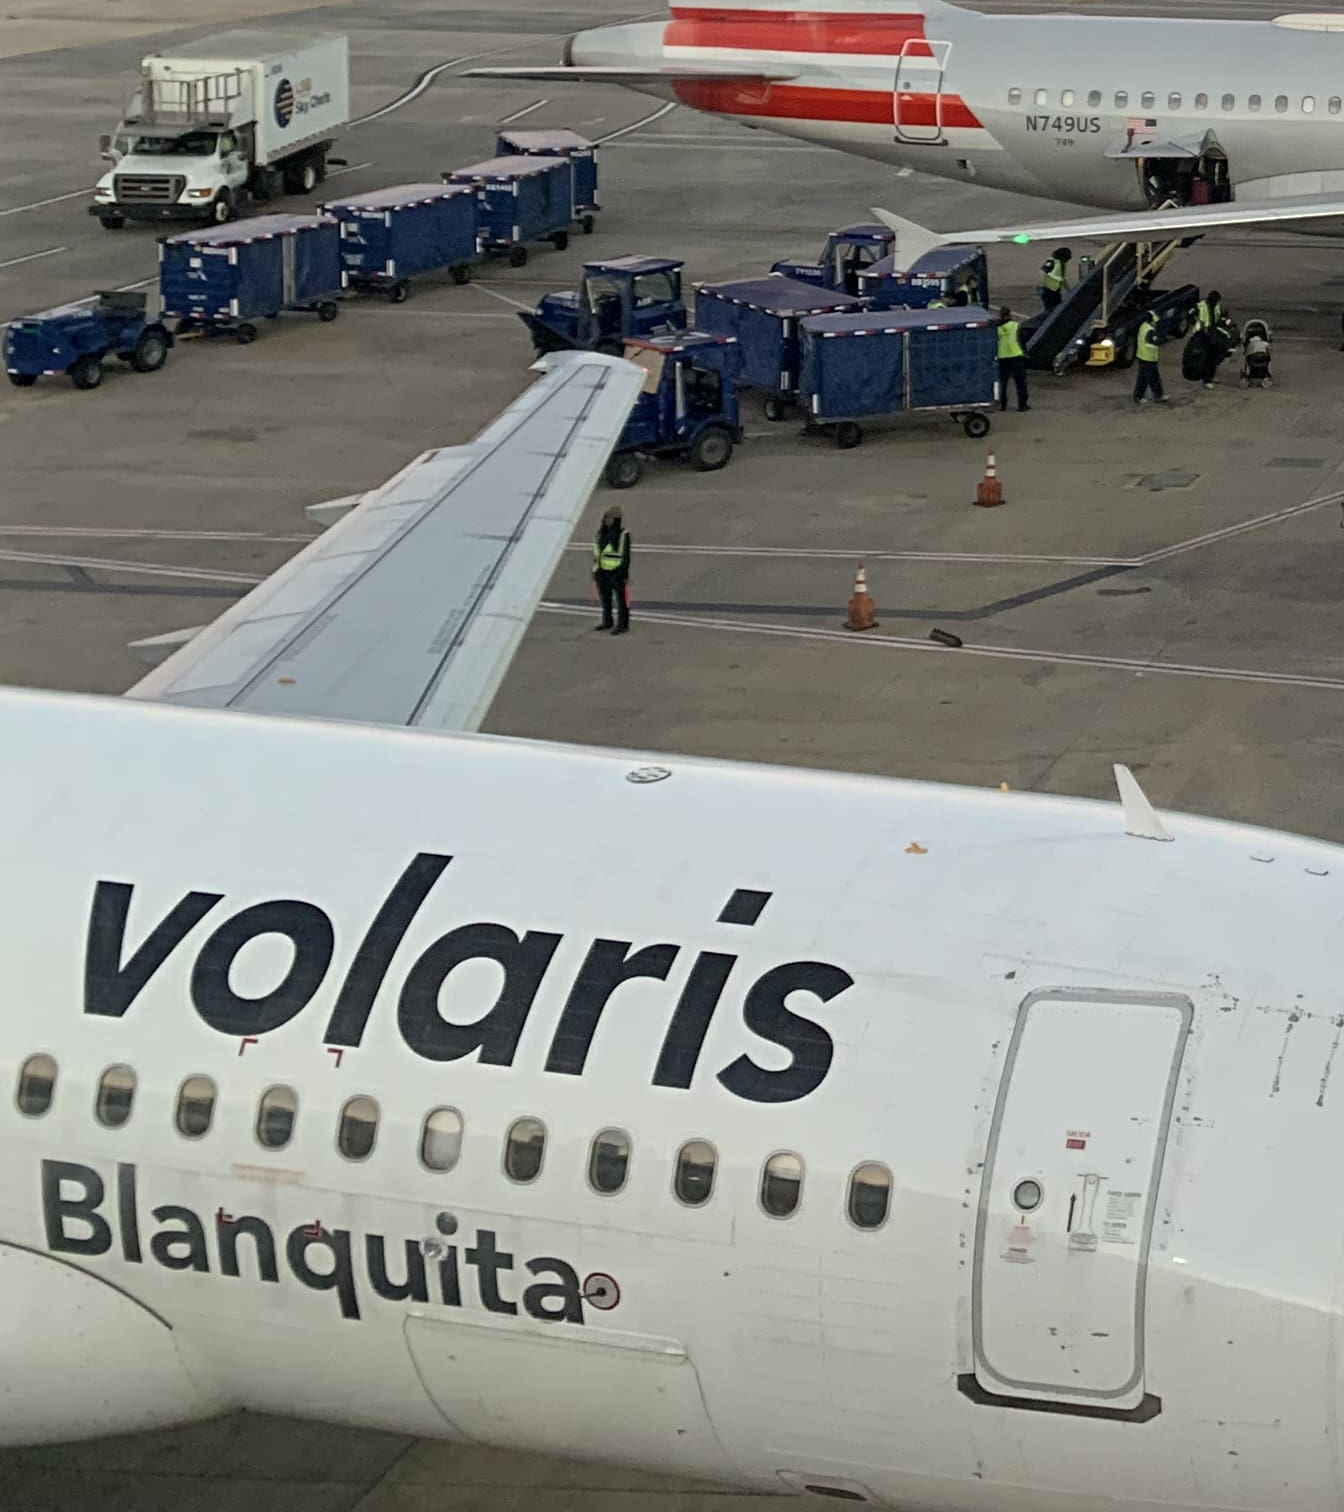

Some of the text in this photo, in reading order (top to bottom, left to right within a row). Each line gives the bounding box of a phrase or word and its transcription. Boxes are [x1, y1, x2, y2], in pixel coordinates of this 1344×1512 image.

[1026, 115, 1101, 133] N749US
[83, 852, 855, 1104] volaris
[41, 1159, 586, 1325] Blanquita
